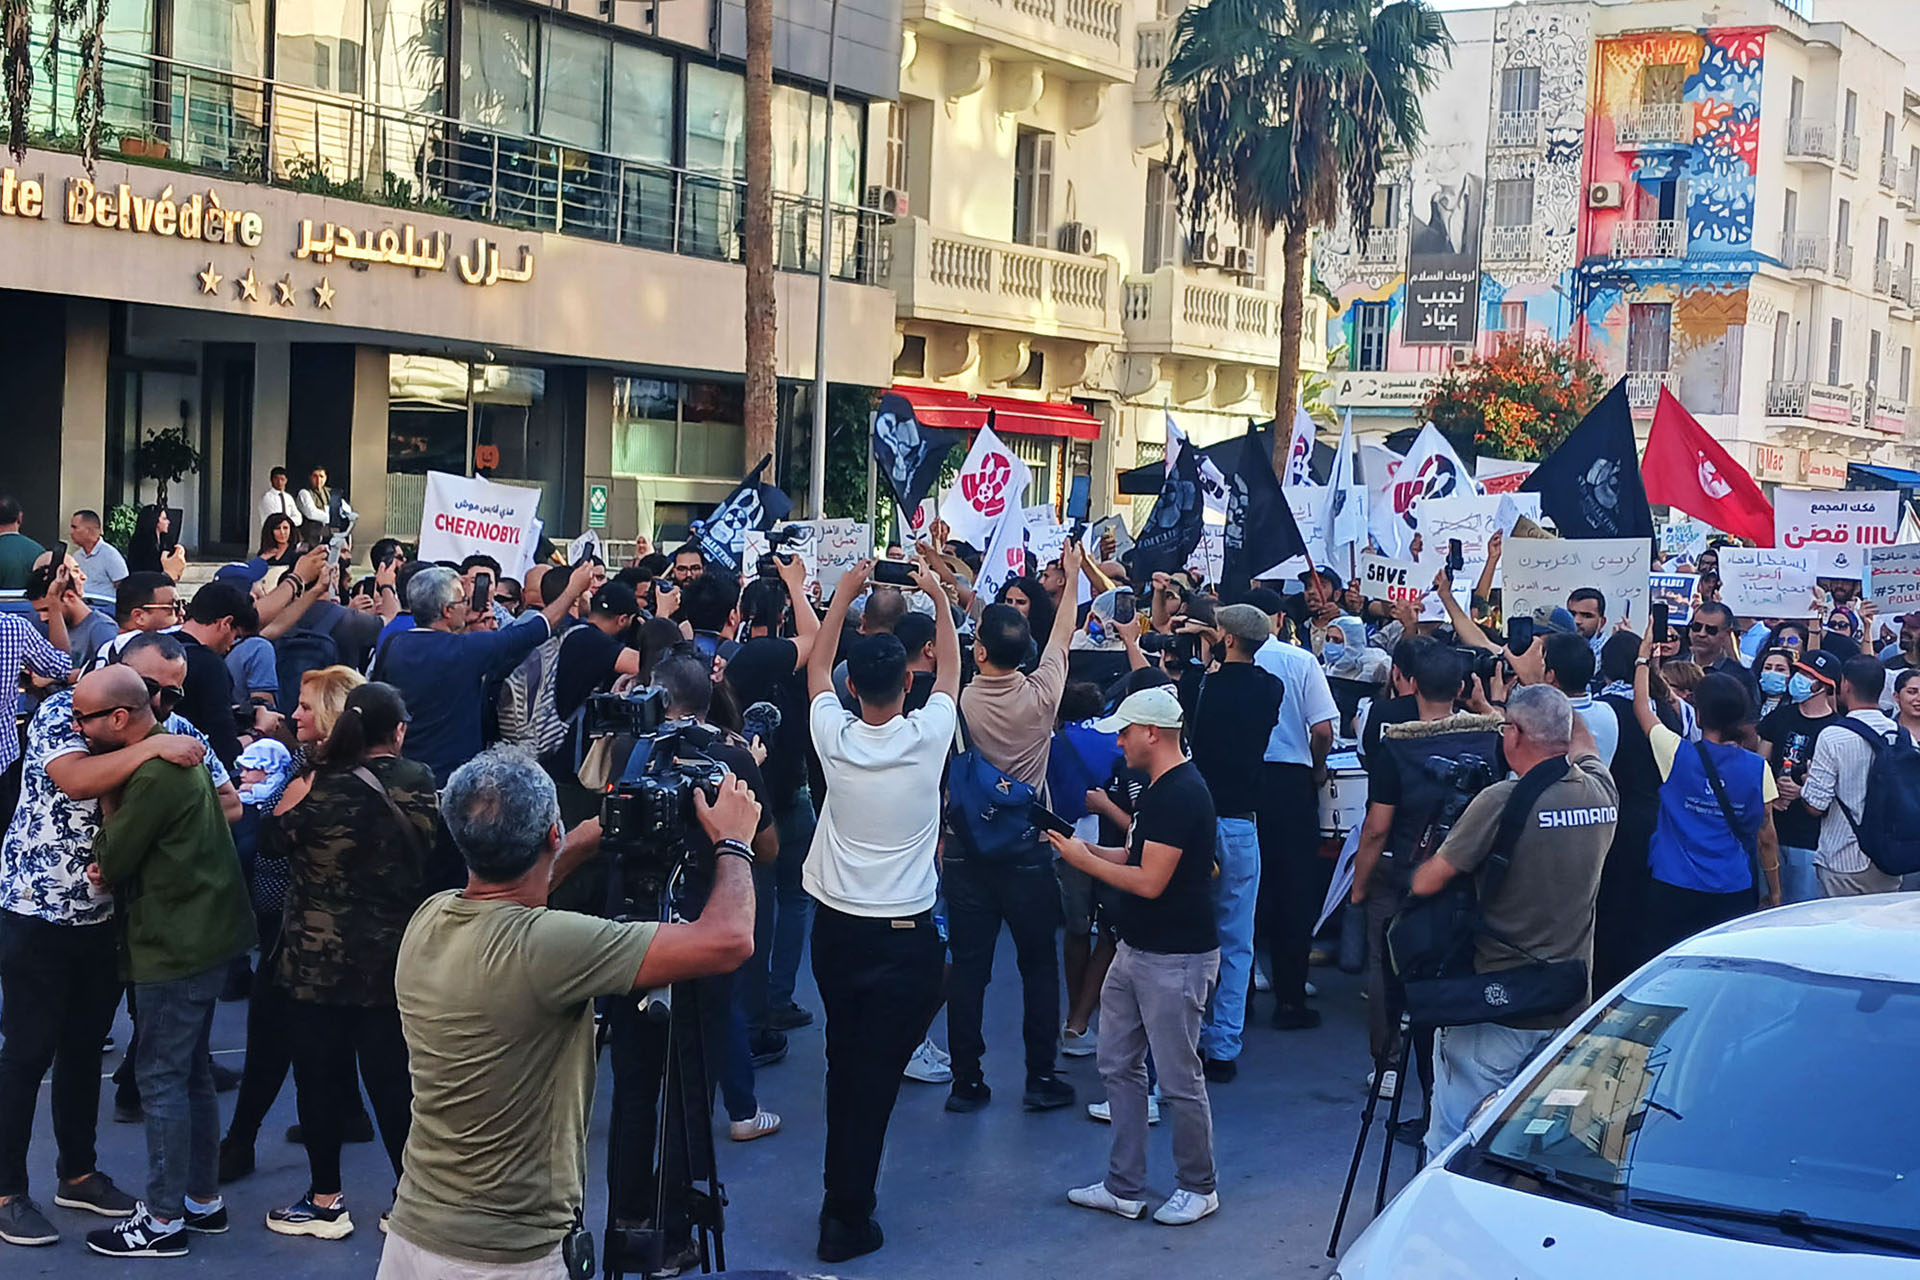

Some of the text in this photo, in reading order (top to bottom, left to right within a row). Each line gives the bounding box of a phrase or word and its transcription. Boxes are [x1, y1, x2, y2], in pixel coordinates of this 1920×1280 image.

[65, 176, 263, 246] Belvédère
[1410, 269, 1444, 285] السلام
[1417, 286, 1465, 308] نجيب
[1422, 307, 1458, 331] عياد
[1766, 448, 1784, 471] Mac
[1810, 503, 1848, 515] المجمع
[1367, 563, 1407, 586] SAVE
[1538, 806, 1618, 828] SHIMANO
